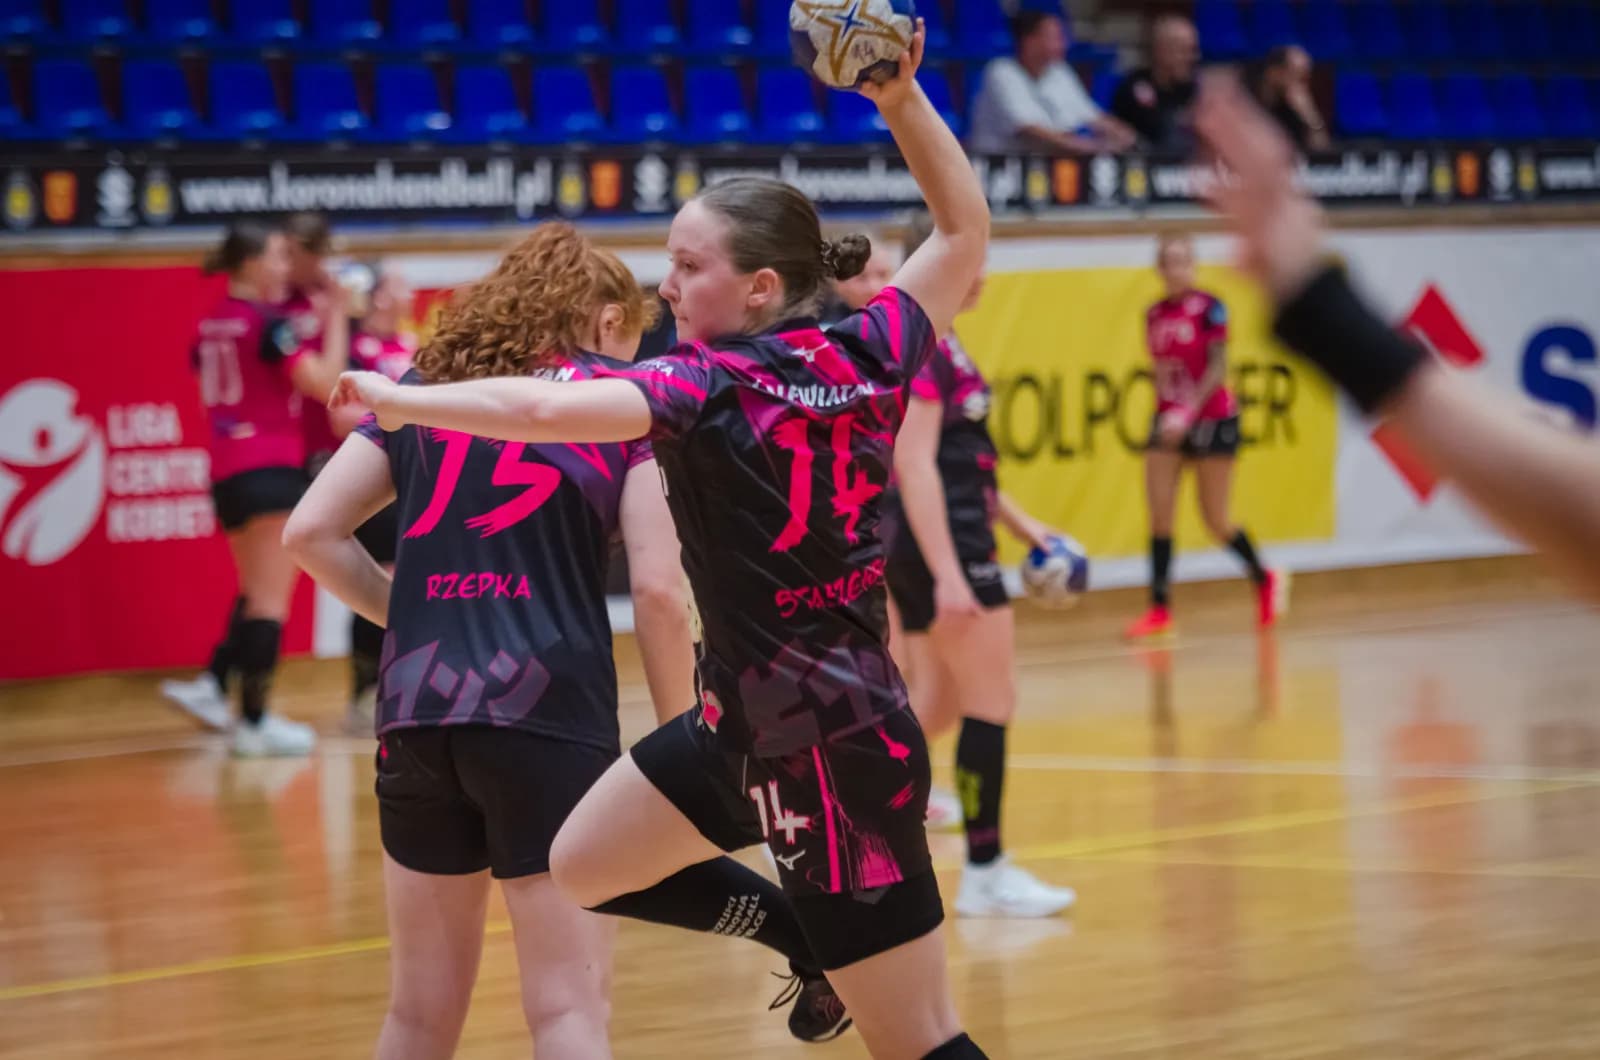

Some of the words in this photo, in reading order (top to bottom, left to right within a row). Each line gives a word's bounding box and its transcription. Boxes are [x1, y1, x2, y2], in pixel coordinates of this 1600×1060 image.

[106, 402, 183, 447] LIGA
[110, 449, 211, 494] CENTR
[402, 427, 562, 539] 15
[768, 413, 884, 553] 14
[426, 571, 532, 601] RZEPKA
[749, 779, 812, 845] 14
